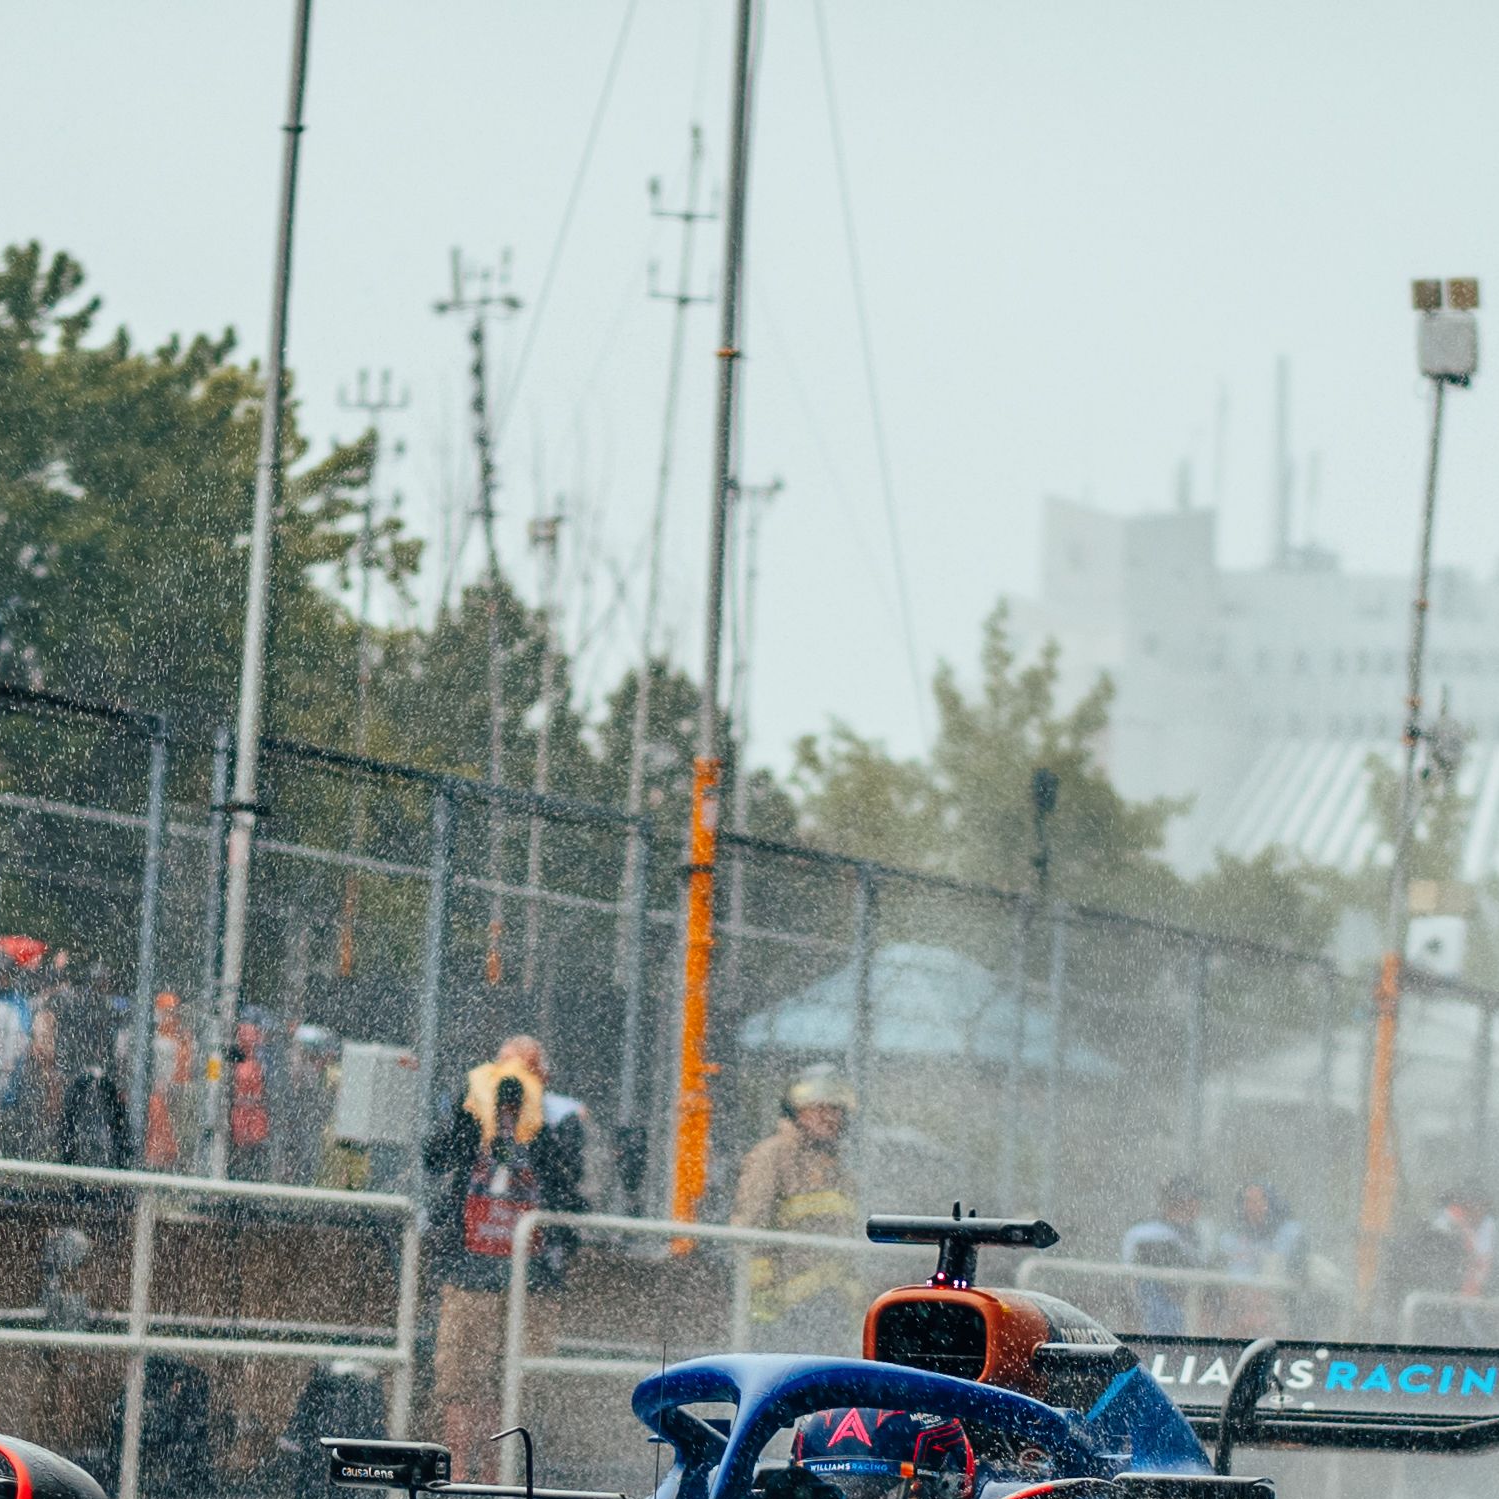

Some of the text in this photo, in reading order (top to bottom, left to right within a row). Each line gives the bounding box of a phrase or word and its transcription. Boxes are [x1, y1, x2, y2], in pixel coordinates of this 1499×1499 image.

[341, 1466, 395, 1480] causaLens
[810, 1462, 889, 1473] WILLIAMS RACING
